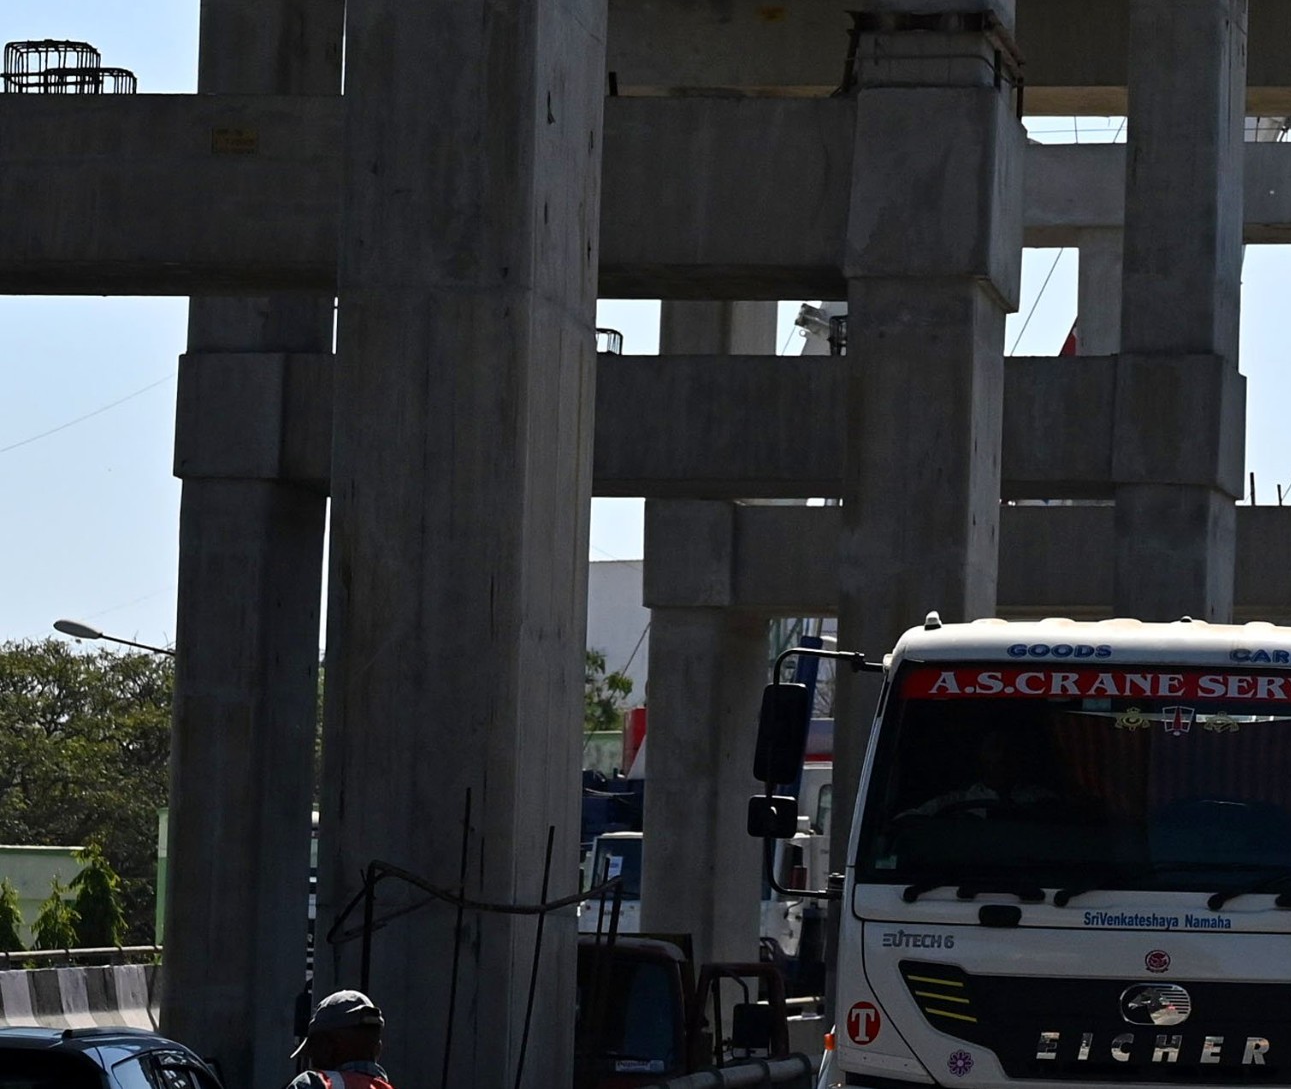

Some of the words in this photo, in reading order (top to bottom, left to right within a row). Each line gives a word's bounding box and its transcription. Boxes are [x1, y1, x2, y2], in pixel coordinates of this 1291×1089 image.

[1006, 644, 1112, 658] GOODS
[928, 671, 1185, 696] A.S.CRANE
[1083, 910, 1179, 930] SriVenkateshaya
[1185, 913, 1231, 930] Namaha
[851, 1008, 876, 1042] T
[1036, 1032, 1270, 1065] EICHER
